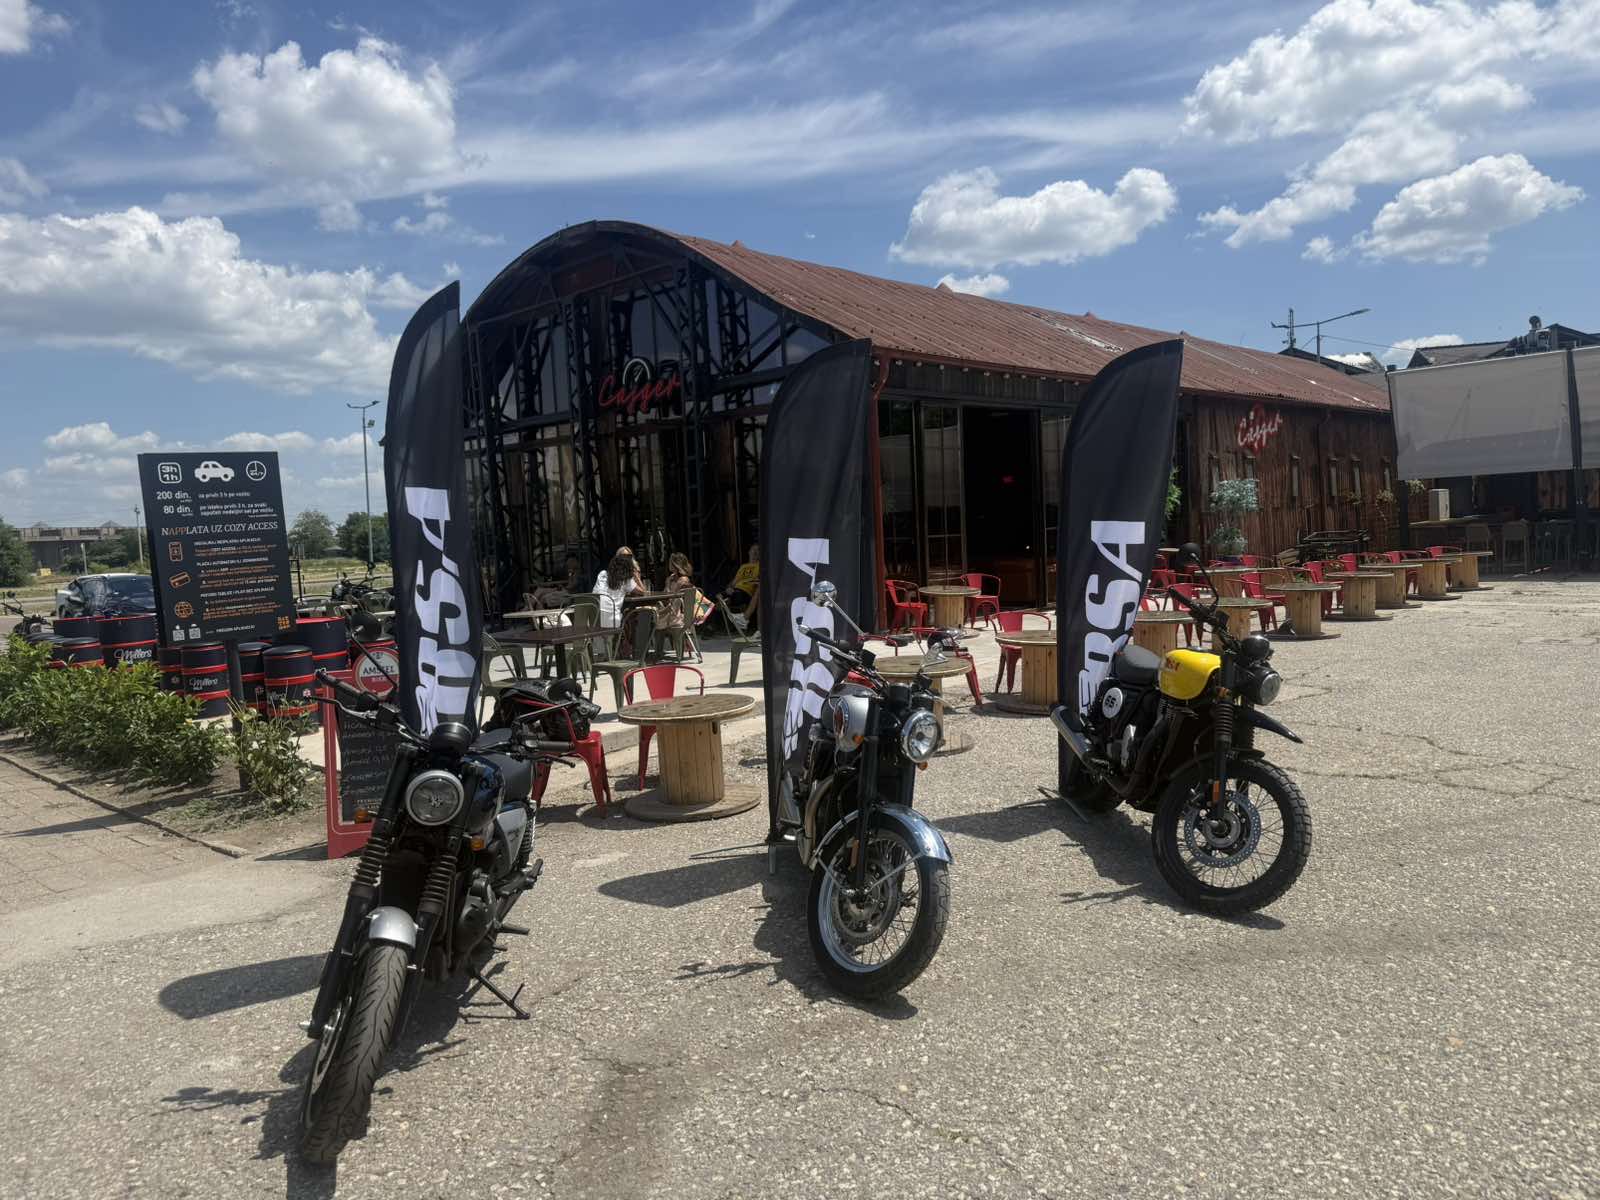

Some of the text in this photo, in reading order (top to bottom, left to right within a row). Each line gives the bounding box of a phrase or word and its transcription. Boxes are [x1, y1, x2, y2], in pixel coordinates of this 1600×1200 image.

[161, 465, 178, 473] 3h
[156, 490, 192, 500] 200 din.
[163, 505, 193, 514] 80 din.
[161, 521, 278, 536] NAPPLATA UZ COZY ACCESS
[362, 665, 395, 675] AMEL
